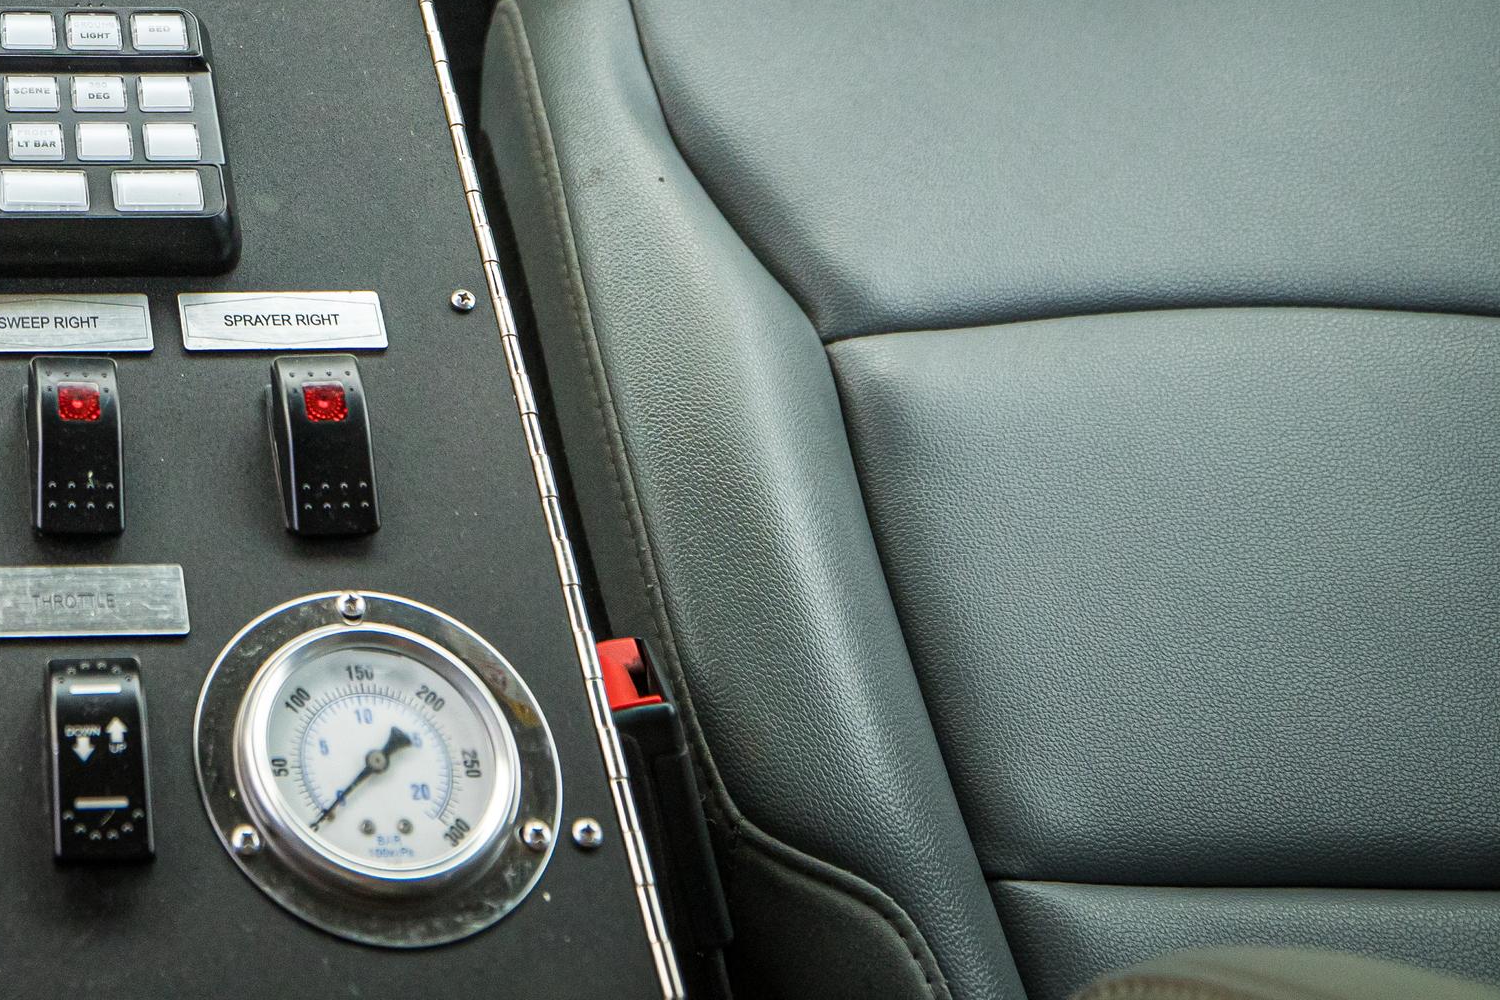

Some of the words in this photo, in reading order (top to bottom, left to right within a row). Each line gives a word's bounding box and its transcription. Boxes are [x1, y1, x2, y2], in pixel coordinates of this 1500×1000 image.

[12, 87, 51, 95] SCENE
[88, 92, 111, 100] DEG
[54, 315, 99, 330] RIGHT
[223, 314, 293, 328] SPRAYER
[296, 313, 340, 327] RIGHT
[31, 592, 116, 609] THROTTLE
[346, 664, 375, 682] 150
[285, 687, 311, 714] 100
[416, 684, 445, 712] 200
[355, 708, 373, 724] 10
[64, 724, 101, 737] DOWN
[108, 743, 127, 754] UP
[271, 757, 290, 777] 50
[461, 749, 482, 779] 250
[410, 783, 431, 801] 20
[444, 818, 471, 848] 300
